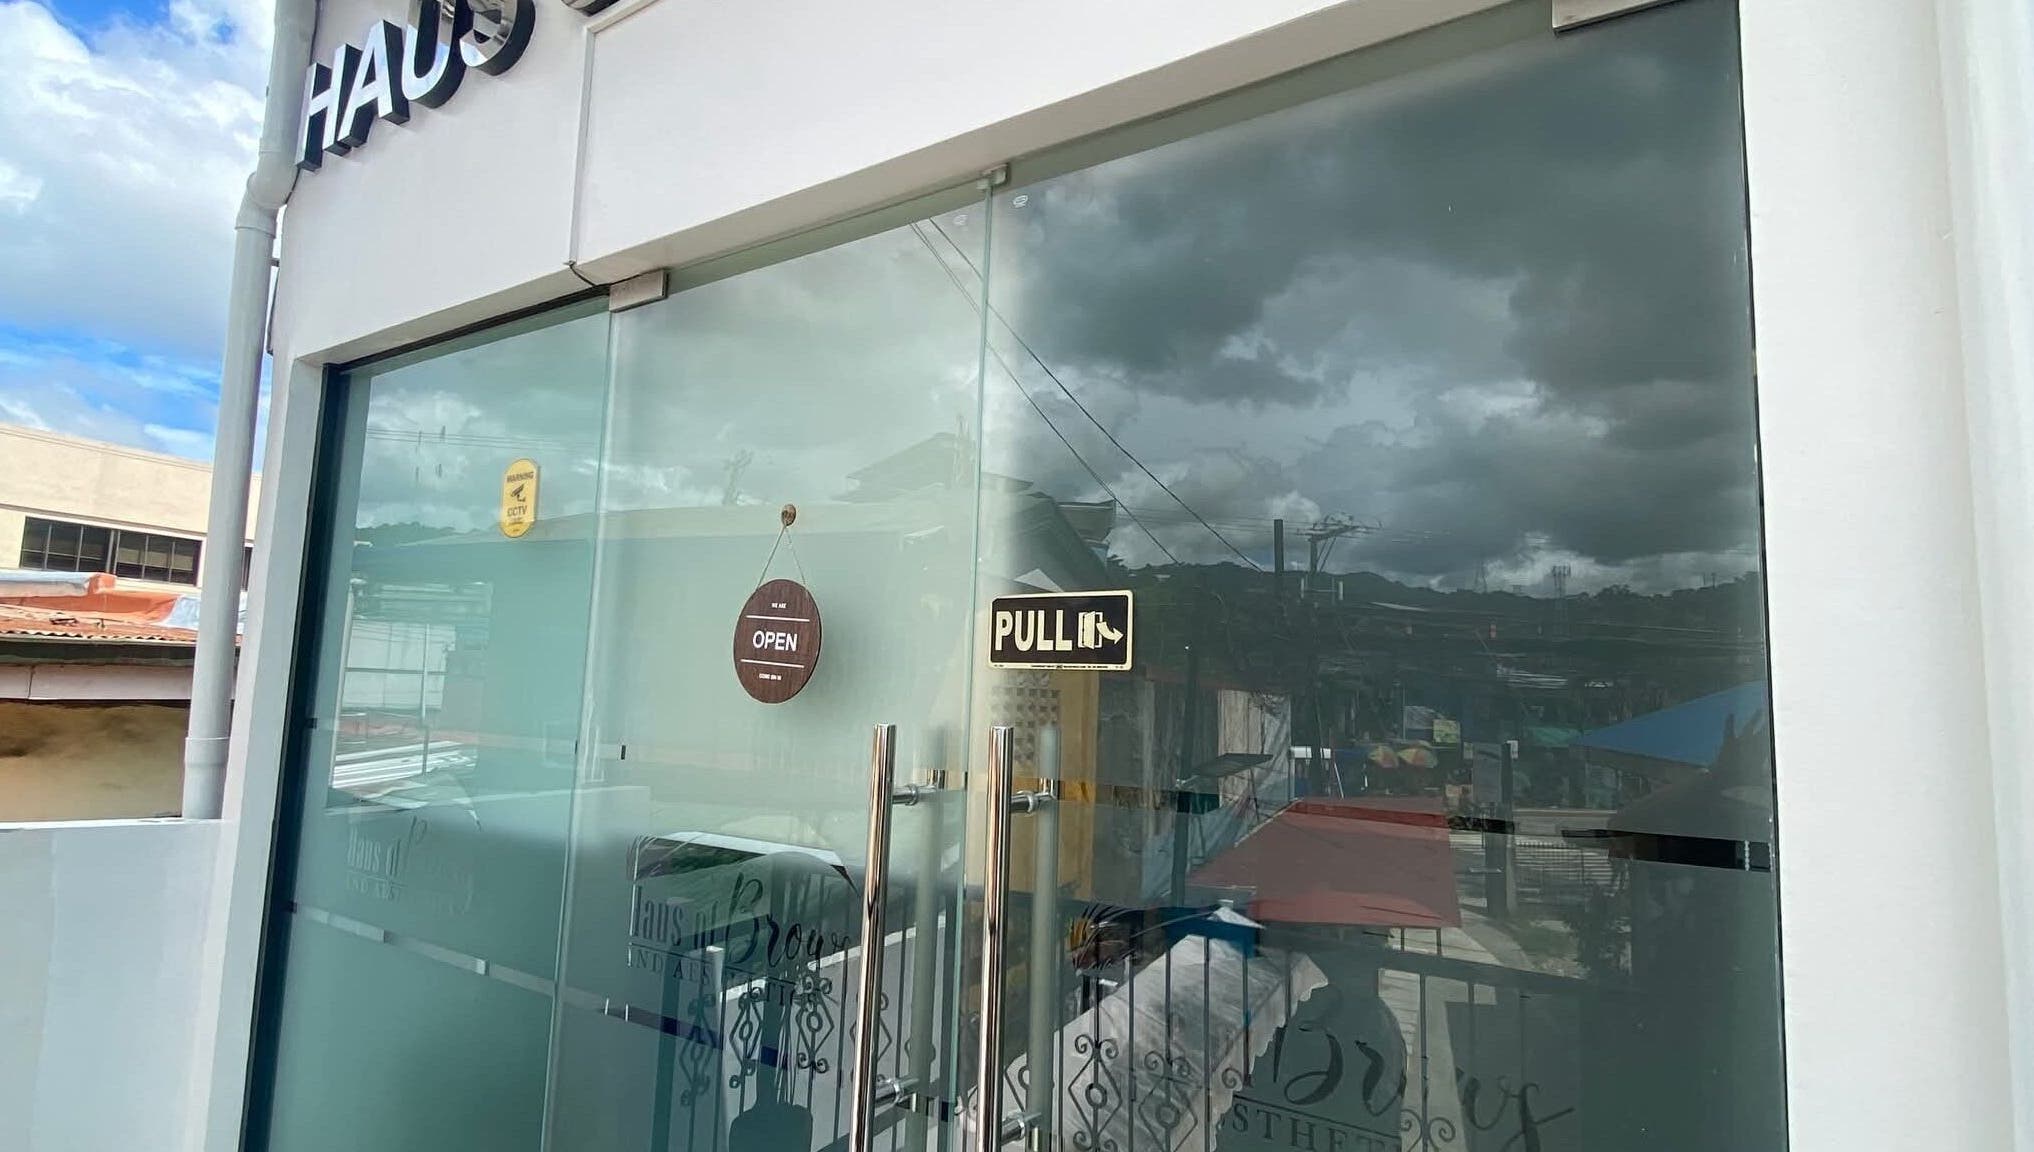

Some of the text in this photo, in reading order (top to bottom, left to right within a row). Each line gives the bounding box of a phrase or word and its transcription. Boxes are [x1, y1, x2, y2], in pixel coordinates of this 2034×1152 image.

[295, 0, 536, 172] HAUS
[506, 471, 535, 483] WARNING
[507, 505, 528, 517] CCTV
[752, 630, 798, 652] OPEN
[994, 609, 1073, 652] PULL
[634, 885, 684, 947] aus
